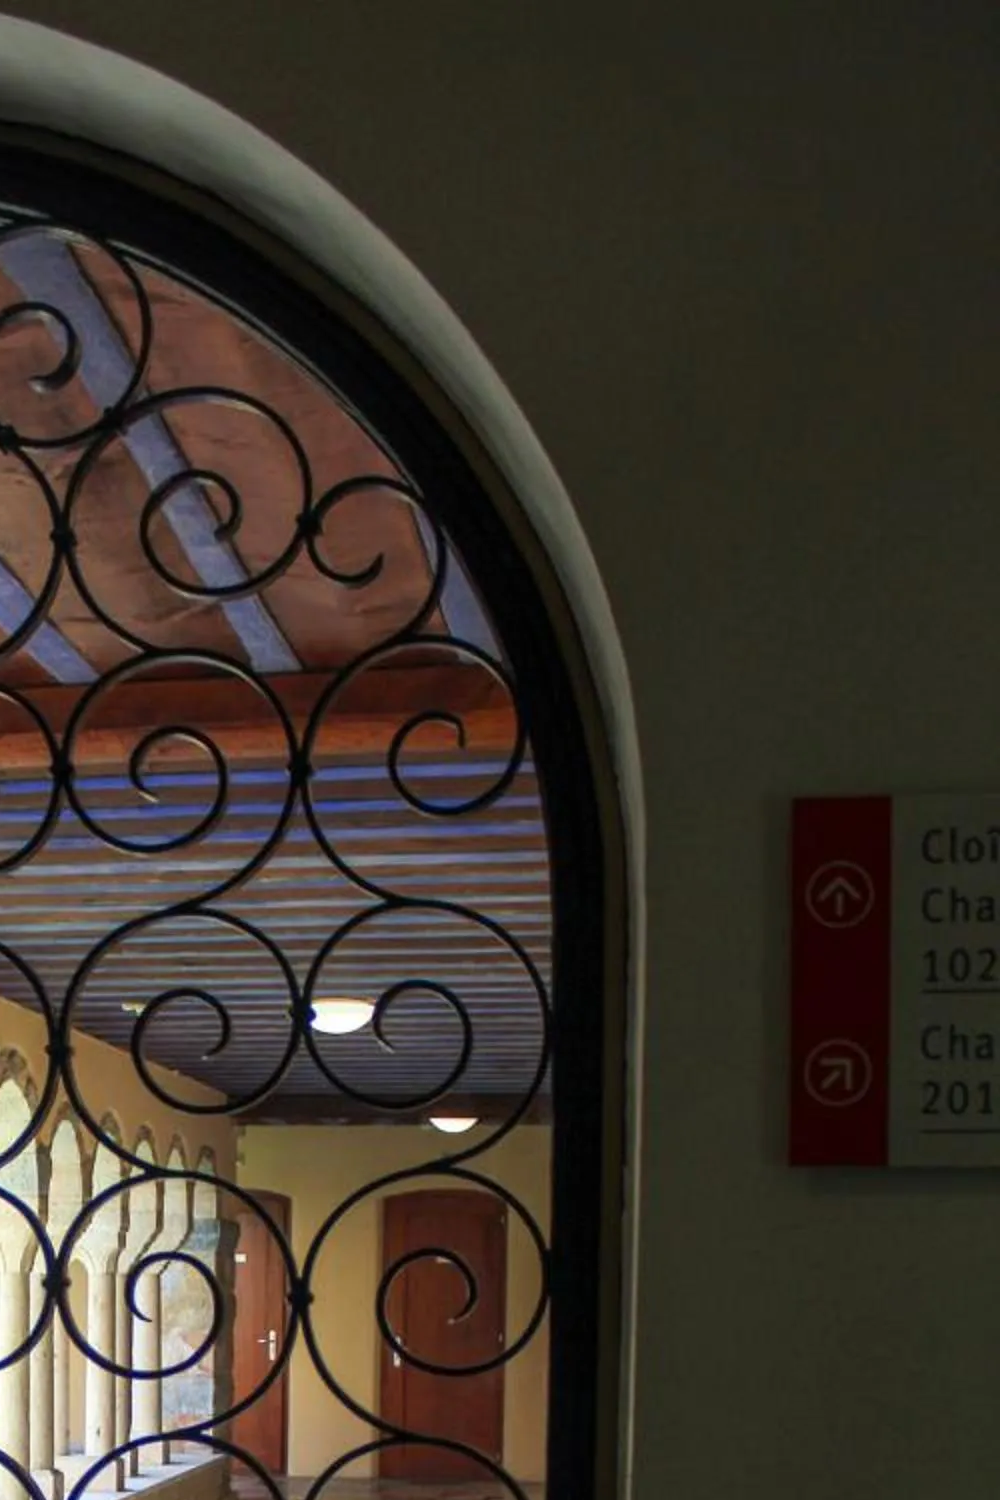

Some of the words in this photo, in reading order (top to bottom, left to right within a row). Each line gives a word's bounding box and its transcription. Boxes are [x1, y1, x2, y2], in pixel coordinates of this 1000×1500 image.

[922, 885, 995, 923] Cha
[922, 948, 999, 983] 102
[921, 1023, 994, 1060] Cha
[921, 1079, 993, 1116] 201
